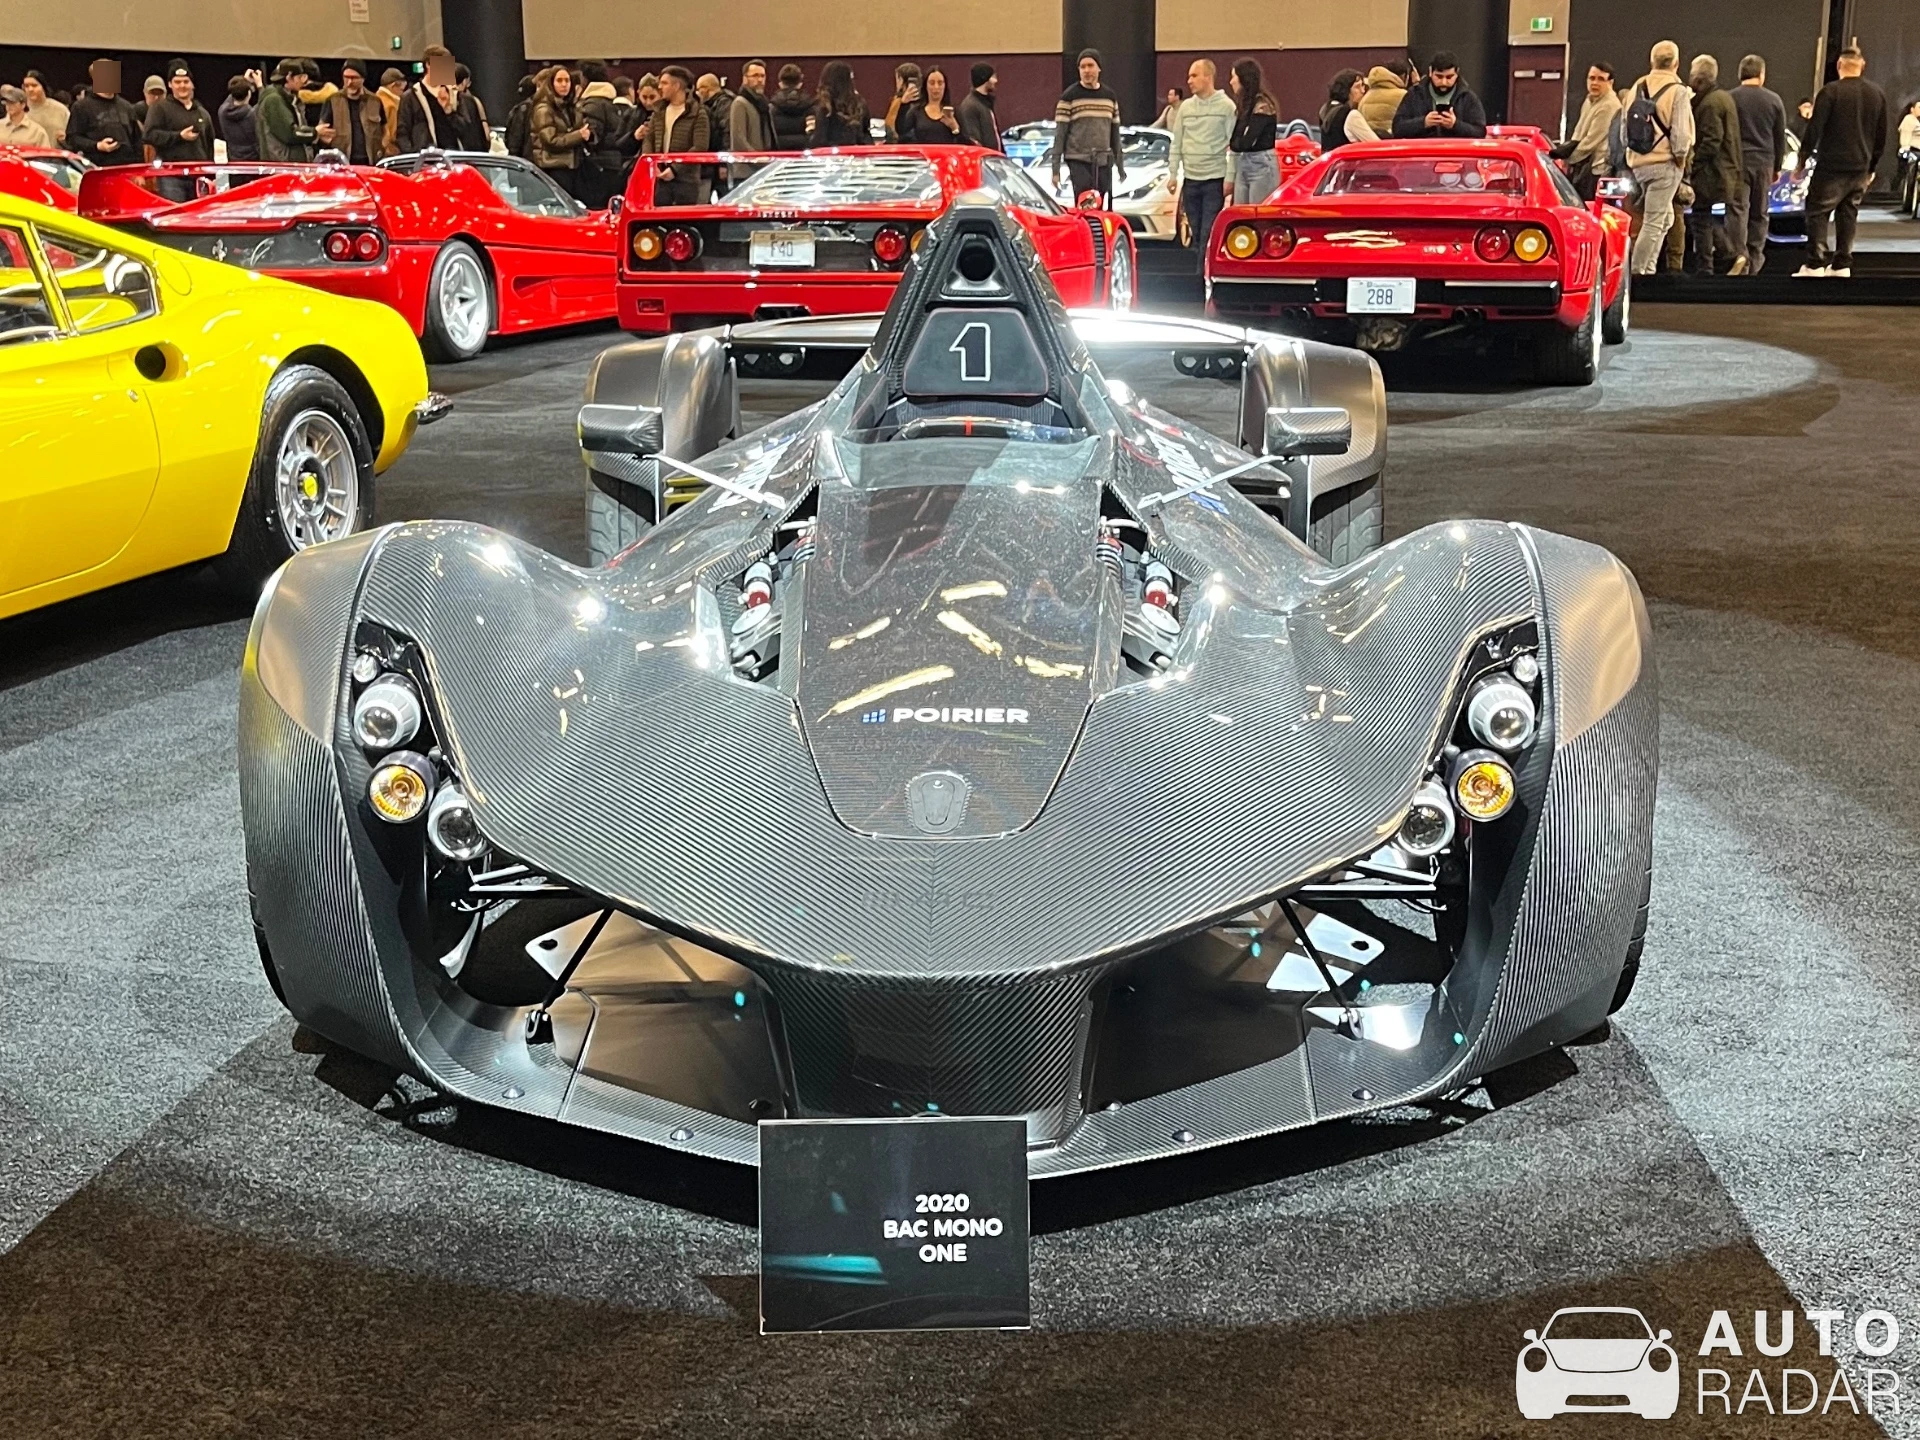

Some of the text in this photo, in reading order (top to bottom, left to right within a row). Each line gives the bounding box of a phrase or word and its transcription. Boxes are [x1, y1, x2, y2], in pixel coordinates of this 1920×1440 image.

[770, 240, 794, 258] F40
[1366, 287, 1395, 306] 288
[948, 322, 992, 382] 1
[892, 707, 1031, 724] POIRIER
[915, 1193, 970, 1213] 2020
[883, 1217, 1004, 1239] BAC MONO
[918, 1243, 968, 1263] ONE
